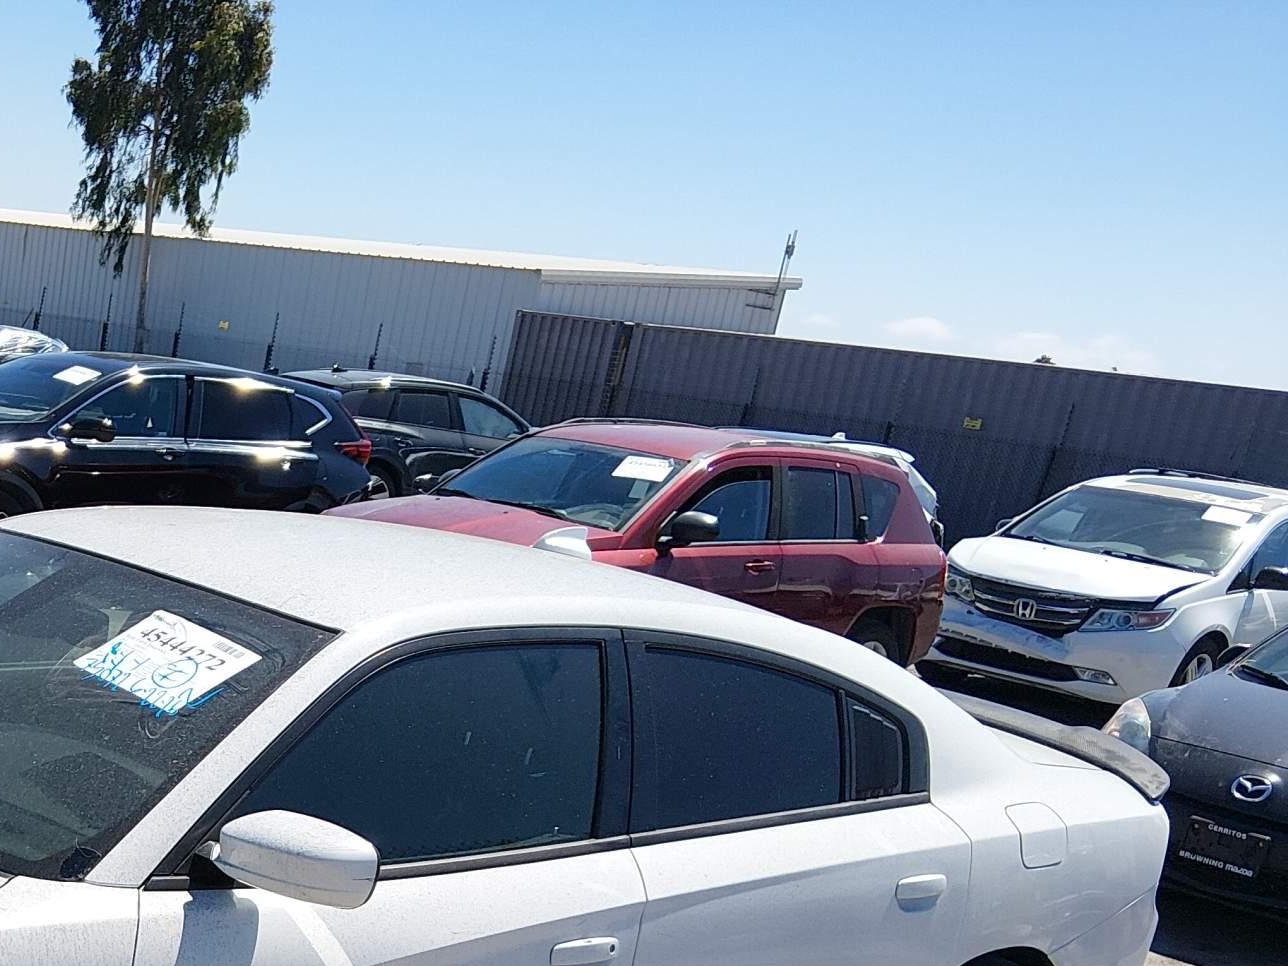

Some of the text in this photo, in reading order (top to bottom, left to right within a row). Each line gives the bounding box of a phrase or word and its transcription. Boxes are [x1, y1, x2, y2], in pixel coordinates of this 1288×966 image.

[140, 627, 226, 671] 45444272
[1207, 823, 1247, 840] CERRITOS
[1178, 850, 1224, 869] BROWNING
